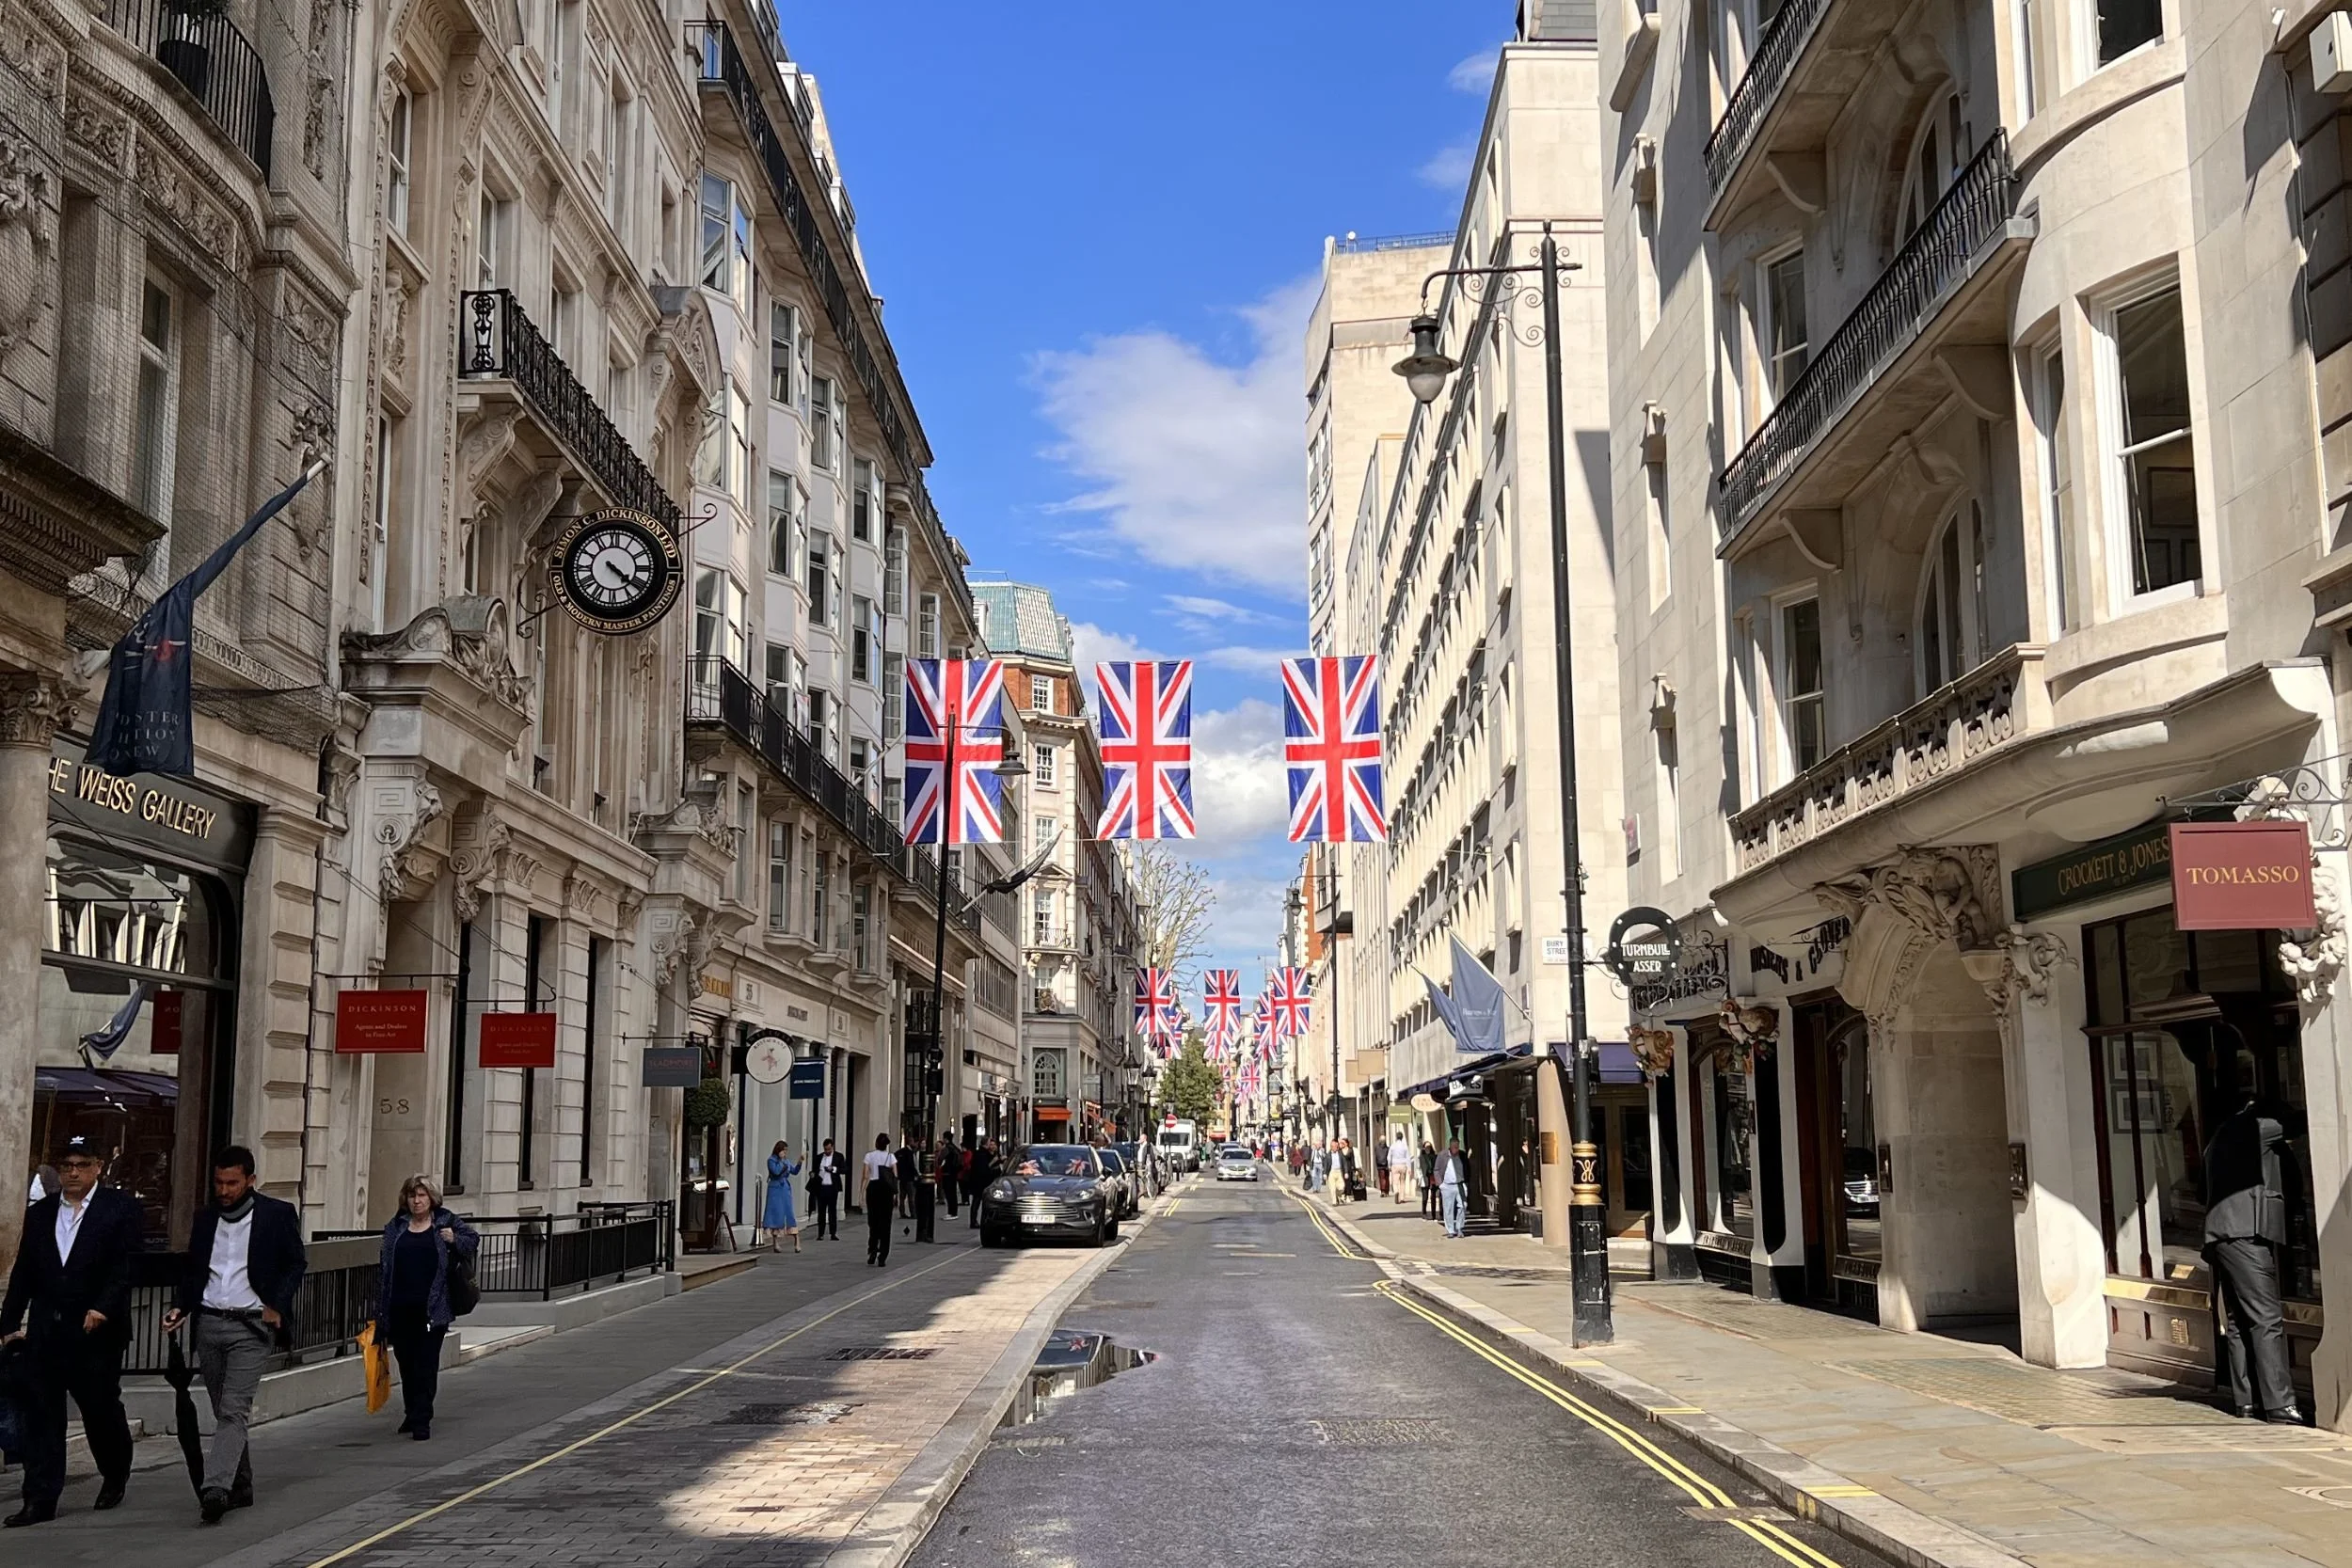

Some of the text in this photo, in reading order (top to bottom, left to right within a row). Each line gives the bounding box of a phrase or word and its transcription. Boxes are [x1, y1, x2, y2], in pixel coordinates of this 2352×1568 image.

[555, 509, 676, 559] SIMON C. DICKINSON LTD
[552, 576, 564, 594] OLD
[565, 602, 601, 628] MODERN
[603, 618, 642, 629] MASTER
[642, 579, 676, 621] PAINTINGS
[49, 757, 216, 839] HE WEISS GALLERY
[2058, 852, 2115, 895] CROCKETT
[2129, 836, 2170, 876] JONES
[2185, 865, 2299, 885] TOMASSO
[1620, 943, 1671, 957] TURNBULL
[1633, 960, 1661, 973] ASSER
[348, 1005, 416, 1013] DICKINSON
[381, 1099, 409, 1114] 58
